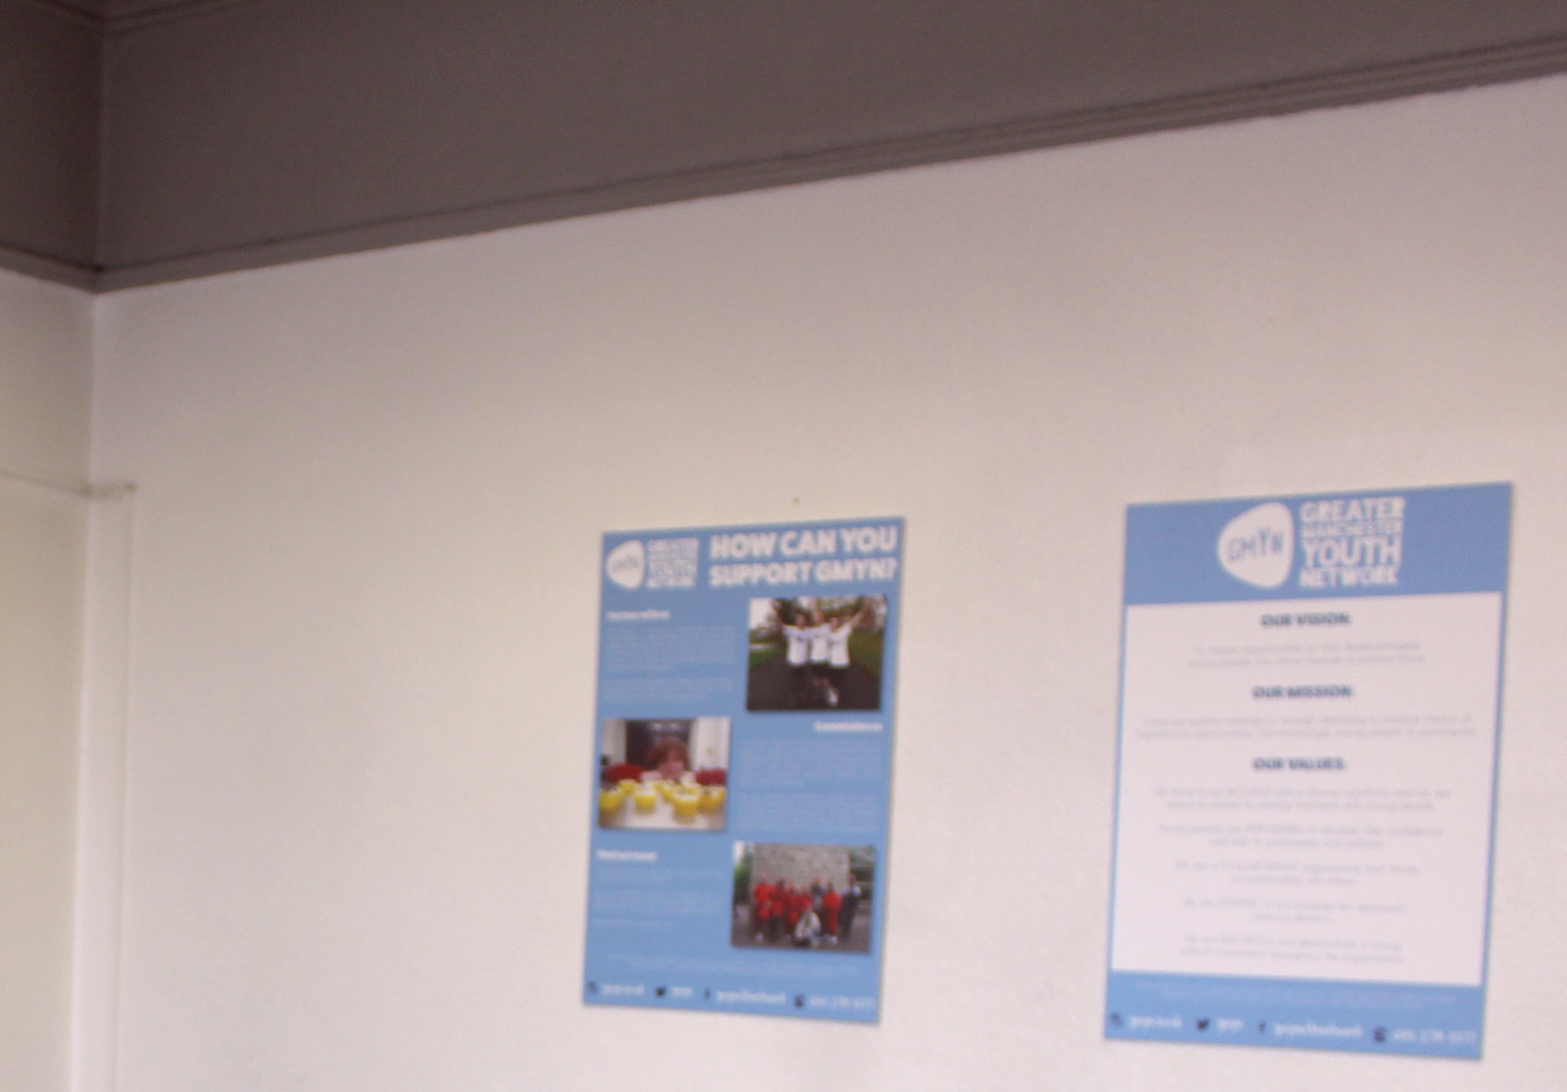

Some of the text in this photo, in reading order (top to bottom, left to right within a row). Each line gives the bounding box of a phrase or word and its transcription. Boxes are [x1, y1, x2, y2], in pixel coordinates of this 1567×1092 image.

[1301, 496, 1405, 522] GREATER
[710, 525, 898, 560] HOW CAN YOU
[1227, 527, 1284, 563] GMYN
[1302, 535, 1403, 568] YOUTH
[709, 556, 898, 587] SUPPORT GMYN?
[1299, 564, 1399, 587] NETWORK
[1261, 613, 1293, 627] OUR
[1252, 685, 1284, 698] OUR
[1252, 757, 1284, 770] OUR
